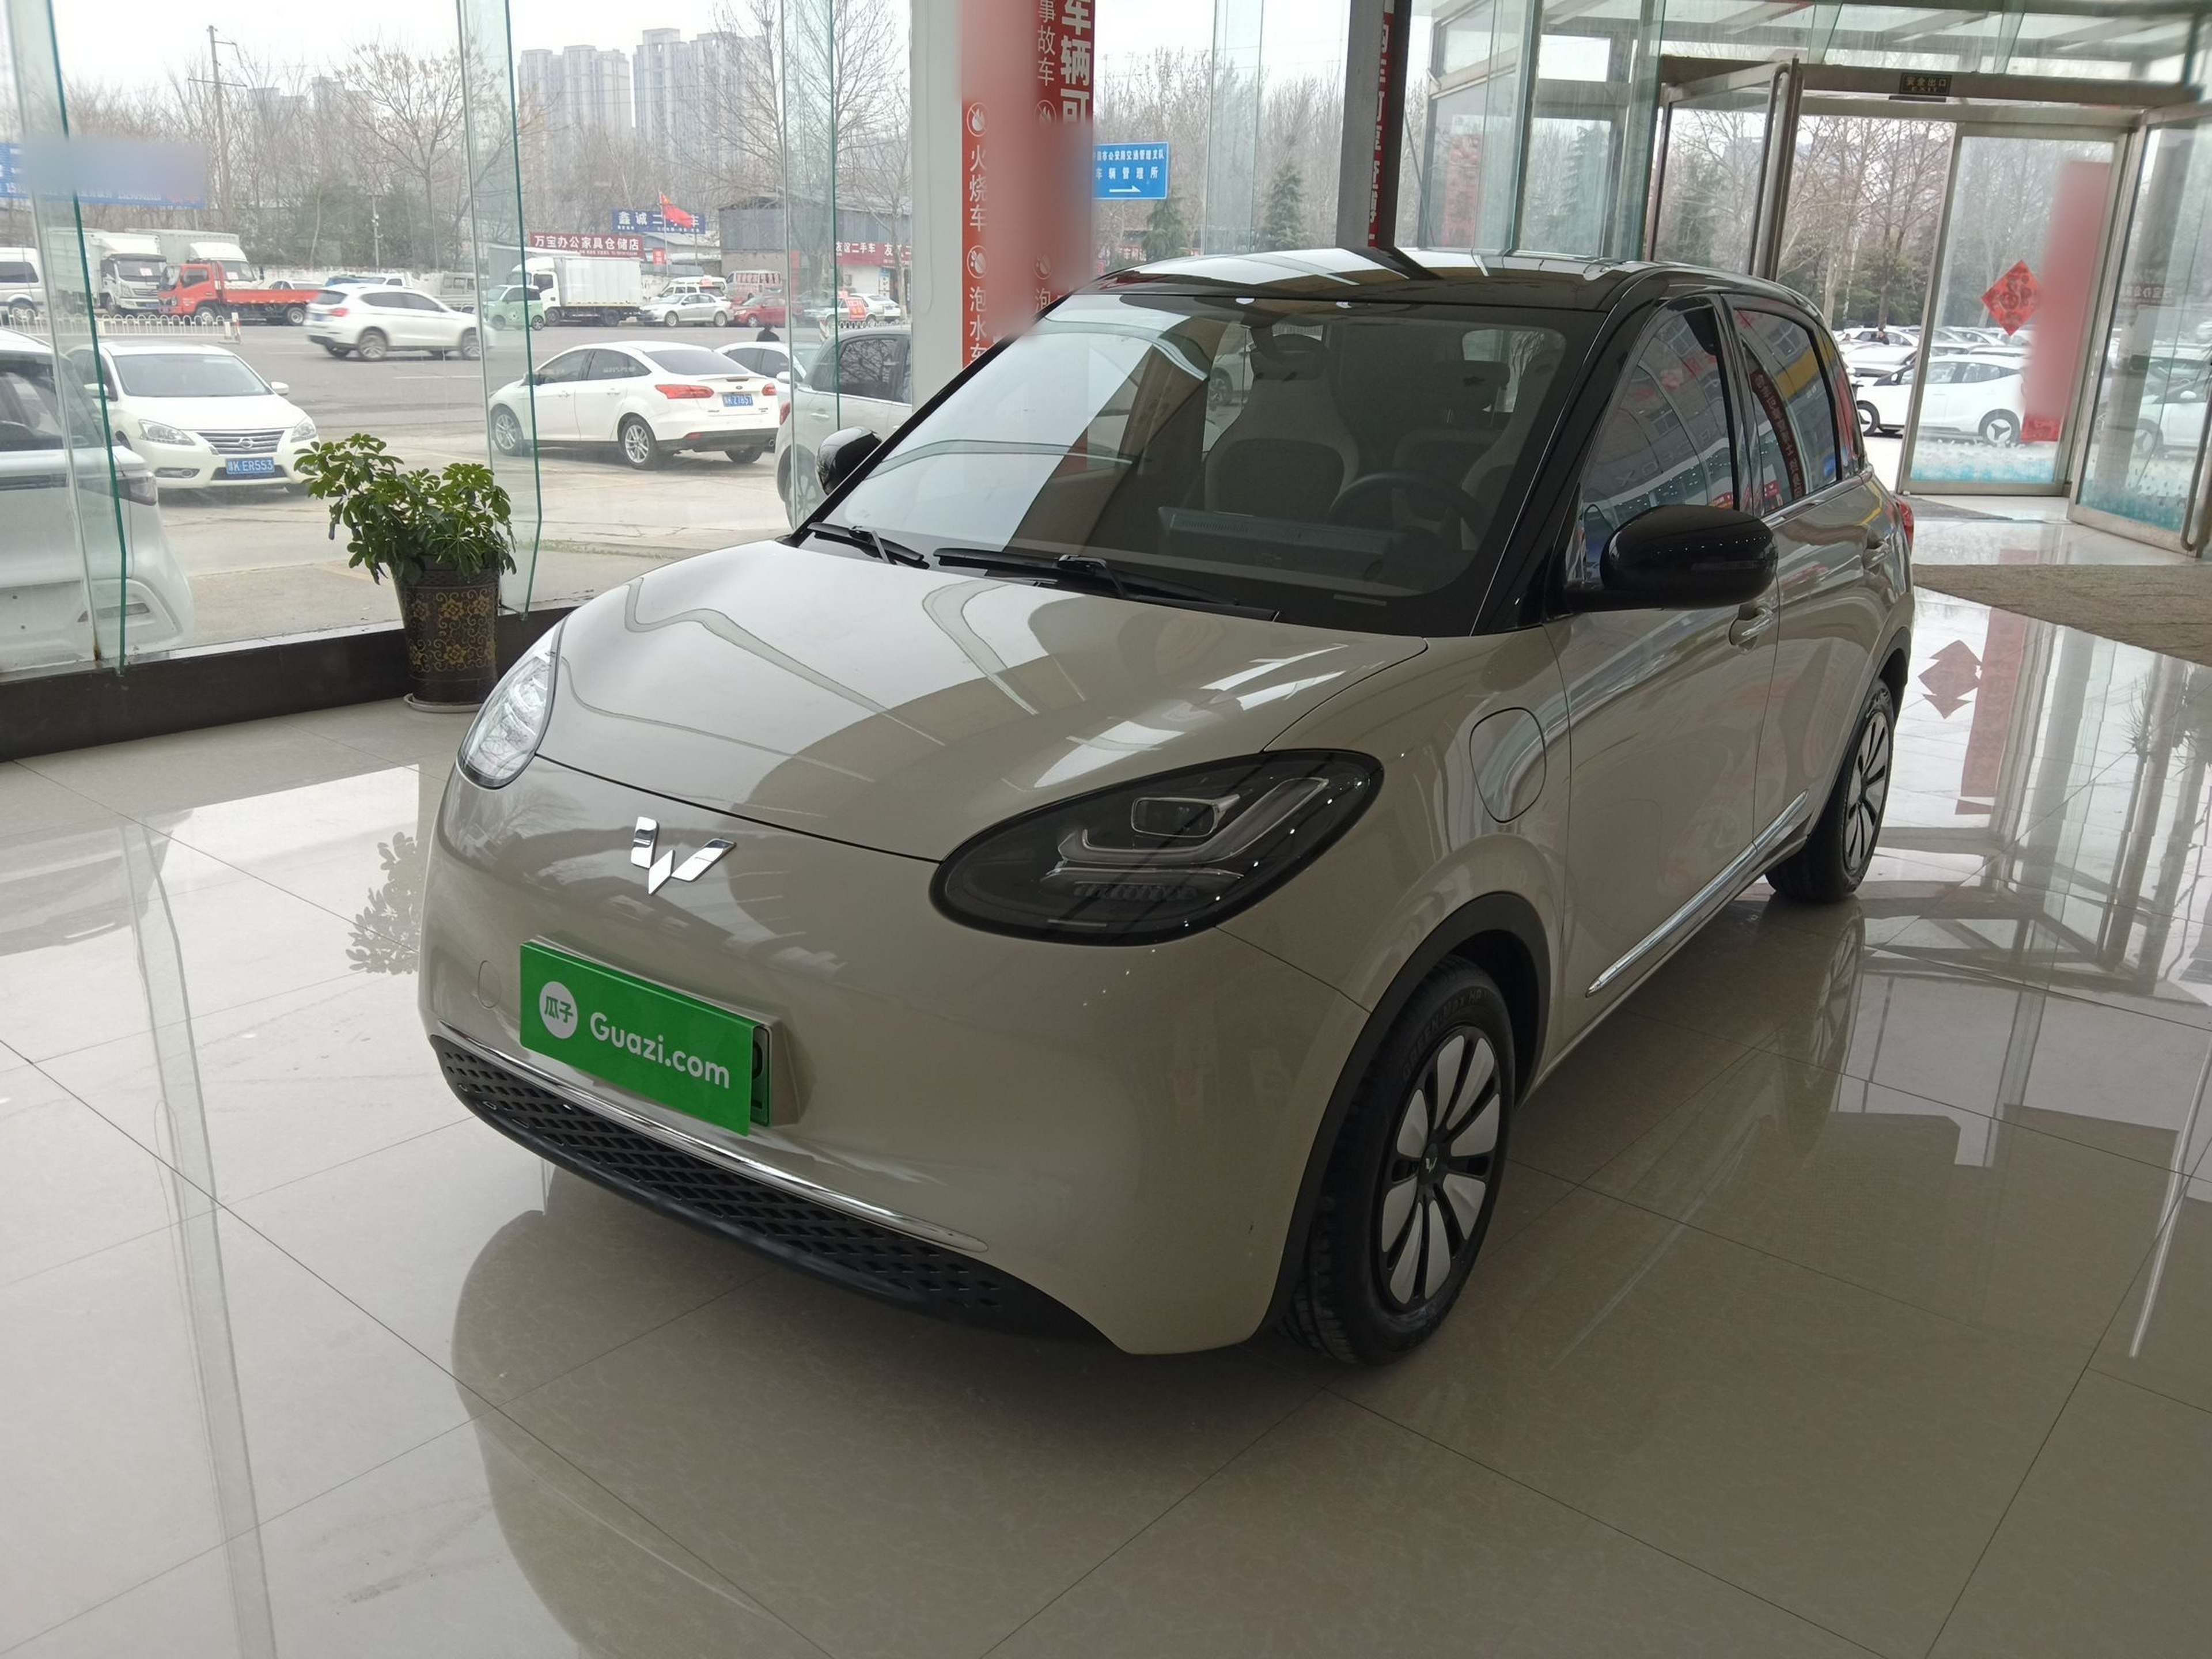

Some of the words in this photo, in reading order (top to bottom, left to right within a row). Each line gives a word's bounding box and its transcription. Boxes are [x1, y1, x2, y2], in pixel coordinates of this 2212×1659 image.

[1094, 149, 1164, 161] 昌市公安局交通管理支队
[1096, 166, 1158, 180] 车辆管理所
[970, 145, 987, 232] 火烧车
[619, 211, 699, 228] 鑫诚二车
[535, 235, 639, 251] 万宝办公家具仓储店
[544, 995, 574, 1023] 瓜子
[590, 1012, 729, 1088] Guazi.com
